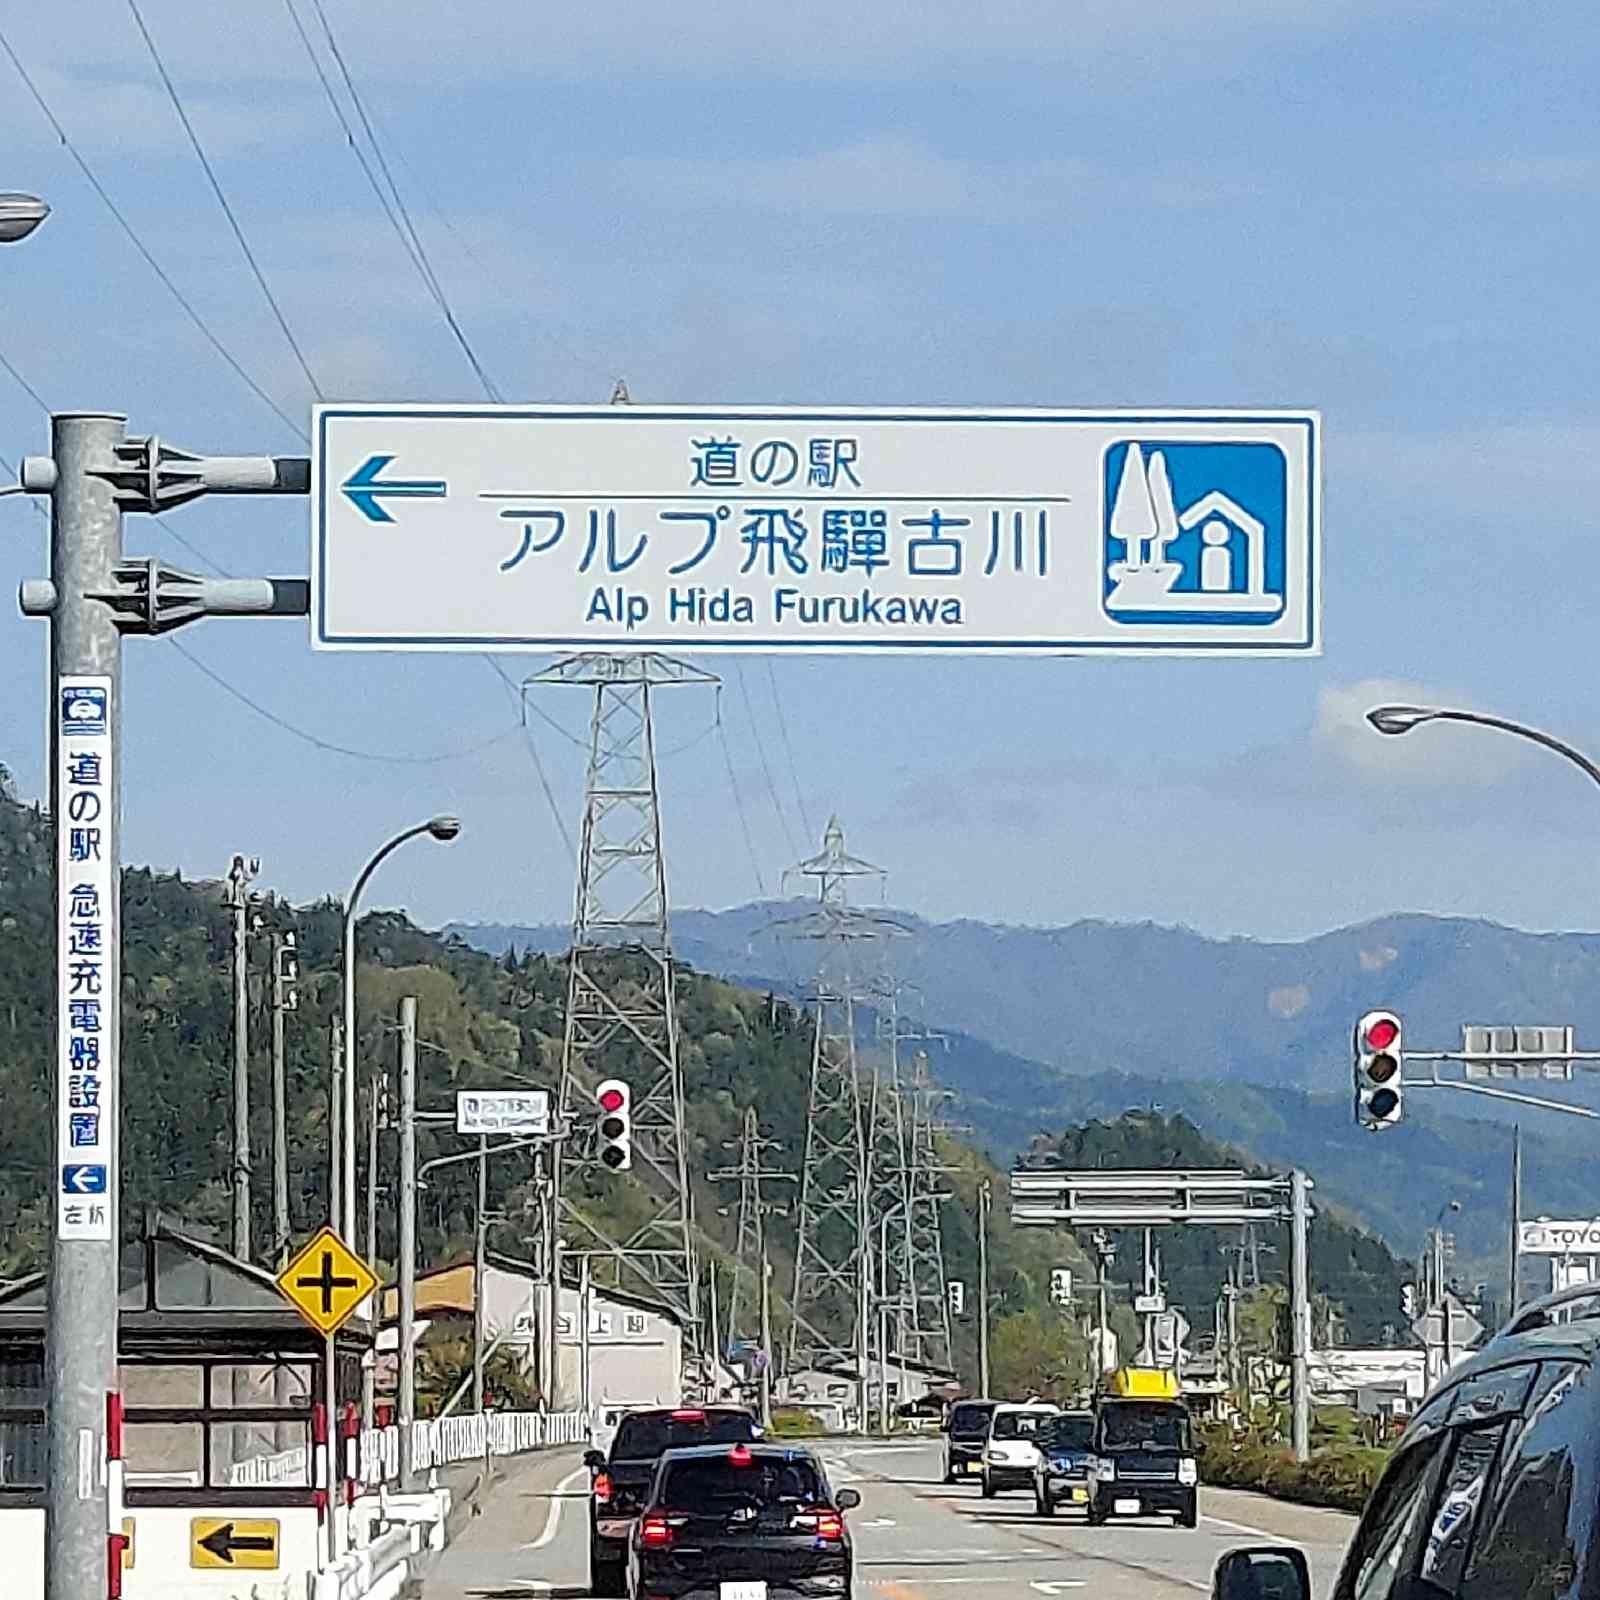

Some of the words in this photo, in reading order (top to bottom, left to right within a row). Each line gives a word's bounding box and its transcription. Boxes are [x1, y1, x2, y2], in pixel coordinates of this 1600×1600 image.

[690, 435, 862, 488] 道の駅
[585, 587, 649, 631] Alp
[669, 587, 754, 624] Hida
[774, 588, 964, 624] Furukawa
[67, 751, 103, 862] 道の駅
